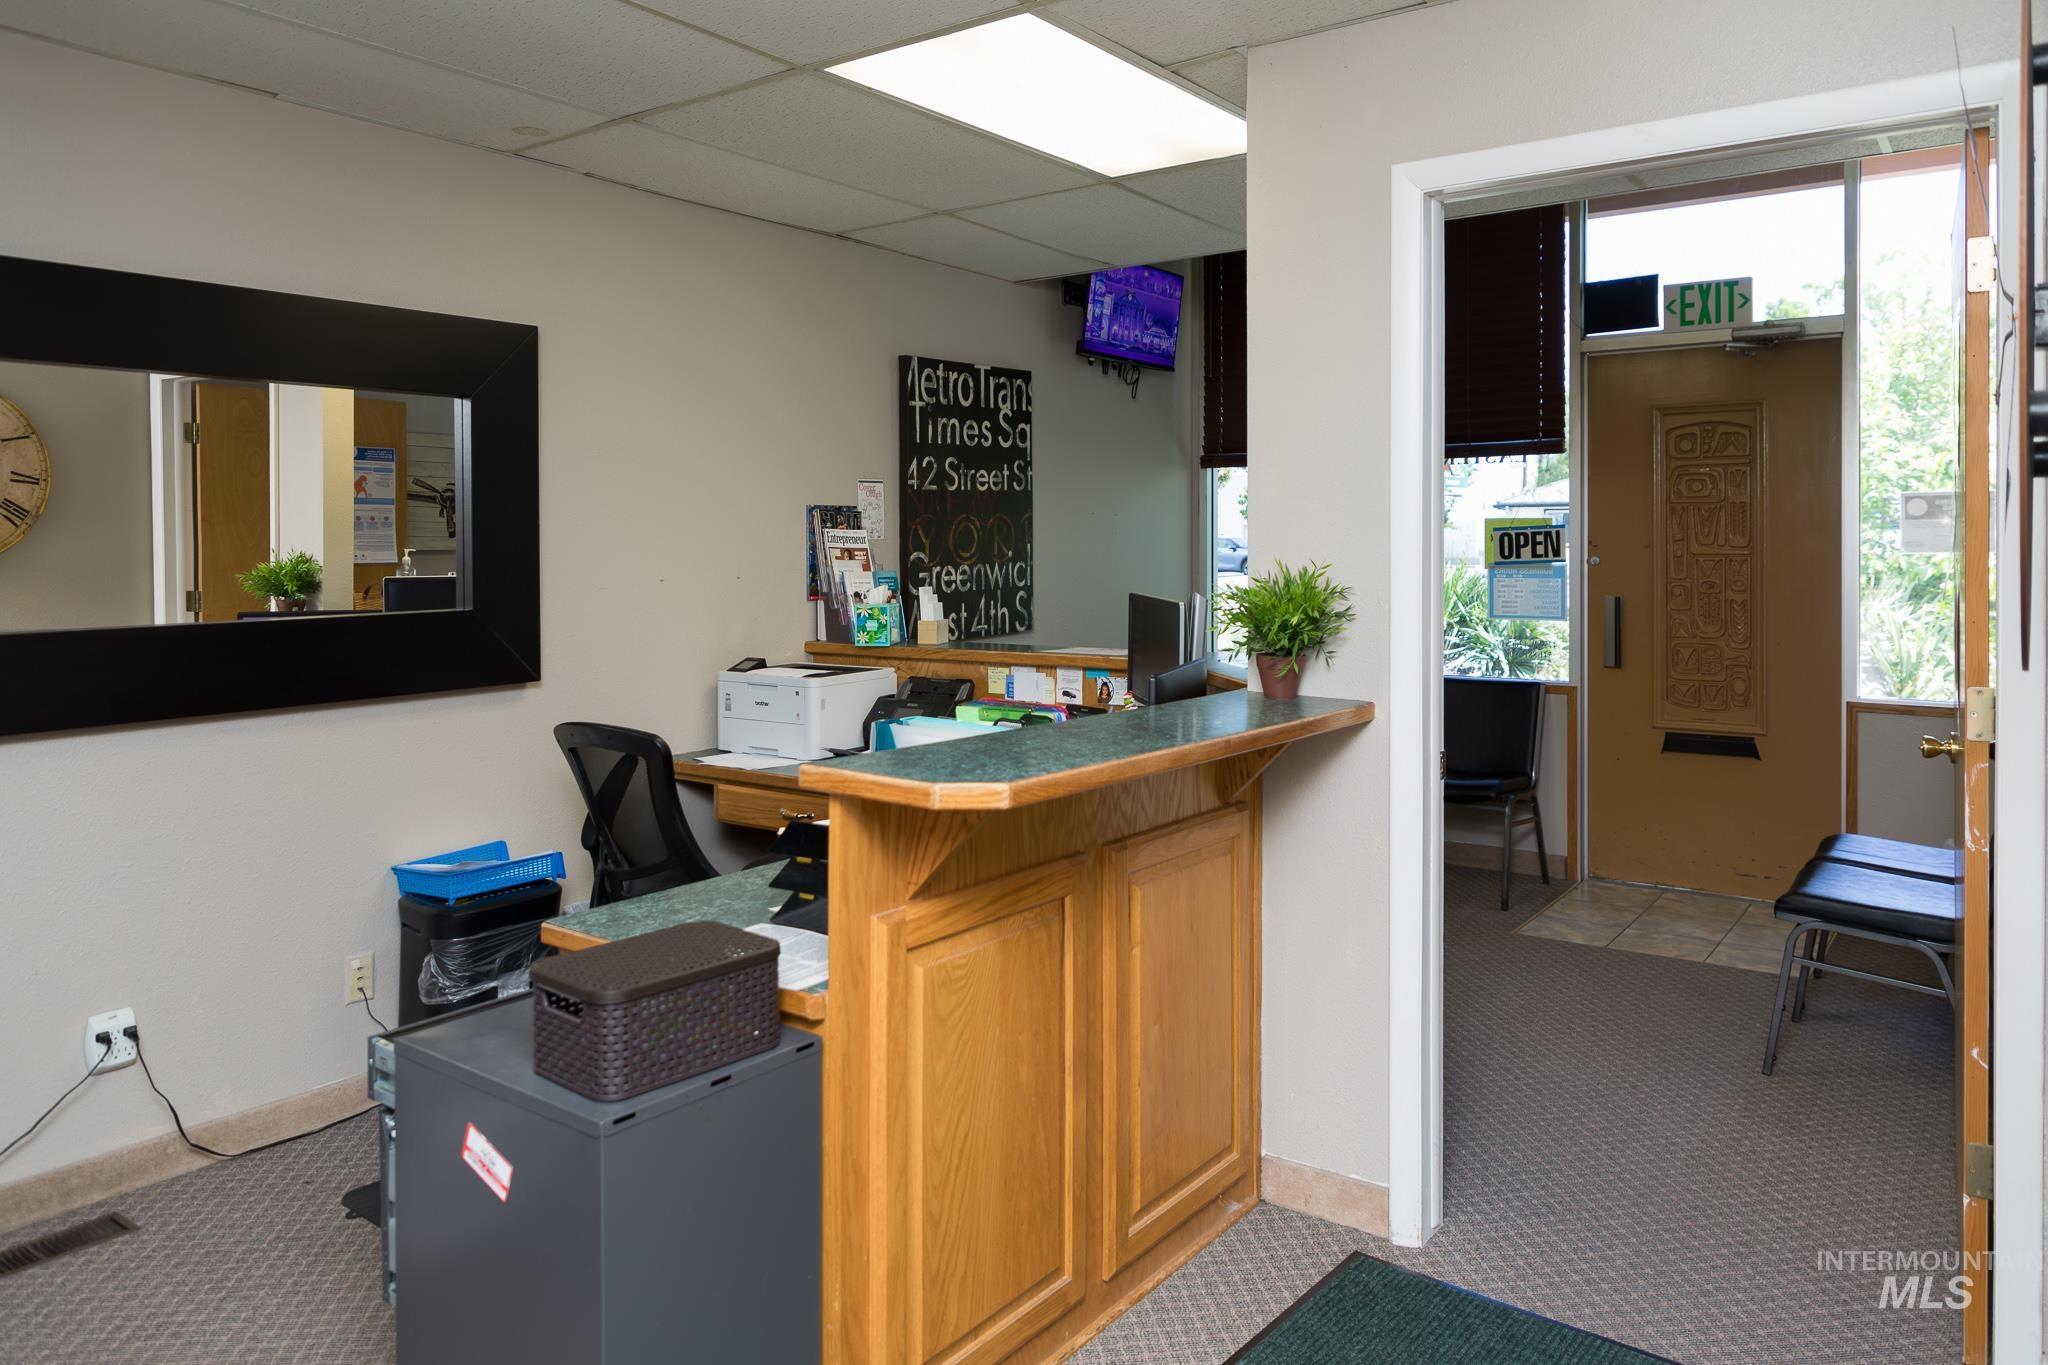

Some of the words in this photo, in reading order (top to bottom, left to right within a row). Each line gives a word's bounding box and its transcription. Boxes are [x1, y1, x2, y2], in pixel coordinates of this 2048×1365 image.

[1680, 280, 1739, 327] EXIT
[909, 401, 992, 447] Times
[998, 408, 1031, 461] Sq
[907, 455, 938, 490] 42
[944, 456, 1009, 491] Street
[826, 530, 867, 547] Entrepreneur
[908, 513, 1032, 564] YOR
[1499, 530, 1561, 560] OPEN
[971, 589, 1009, 637] 4th
[1014, 590, 1033, 632] S
